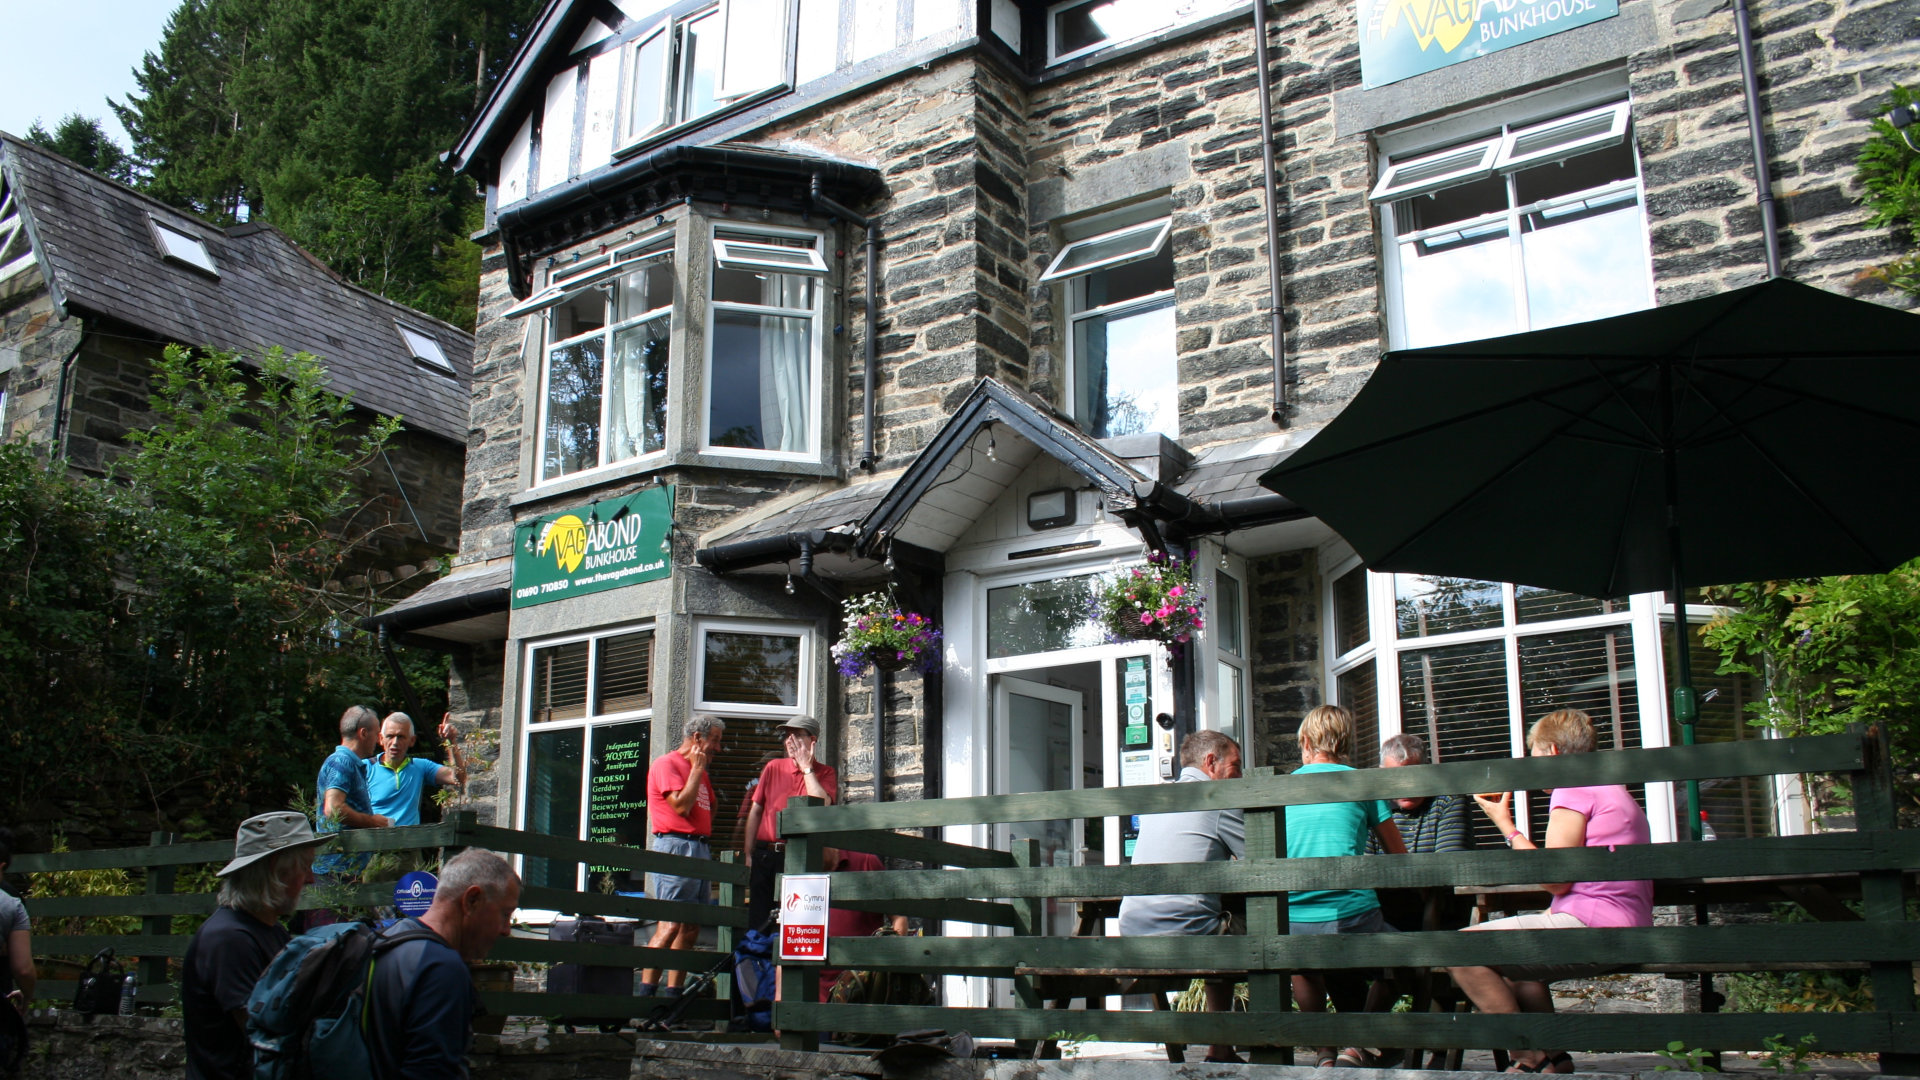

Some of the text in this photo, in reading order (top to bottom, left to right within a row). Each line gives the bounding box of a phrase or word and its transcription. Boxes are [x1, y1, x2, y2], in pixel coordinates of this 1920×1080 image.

[1480, 0, 1596, 43] BUNKHOUSE
[554, 513, 641, 561] VAGABOND
[585, 545, 638, 570] BUNKHOUSE
[516, 559, 665, 599] 01690 710850 www.thevagabond.co.uk
[605, 741, 640, 751] Independent
[604, 750, 640, 761] HOSTEL
[592, 775, 625, 784] CROESO
[592, 784, 624, 793] Gerddwyr
[619, 800, 647, 810] Mynydd
[591, 826, 617, 834] Walkers
[590, 835, 616, 843] Cyclists
[803, 894, 825, 903] Cymru
[786, 936, 820, 944] Bunkhouse
